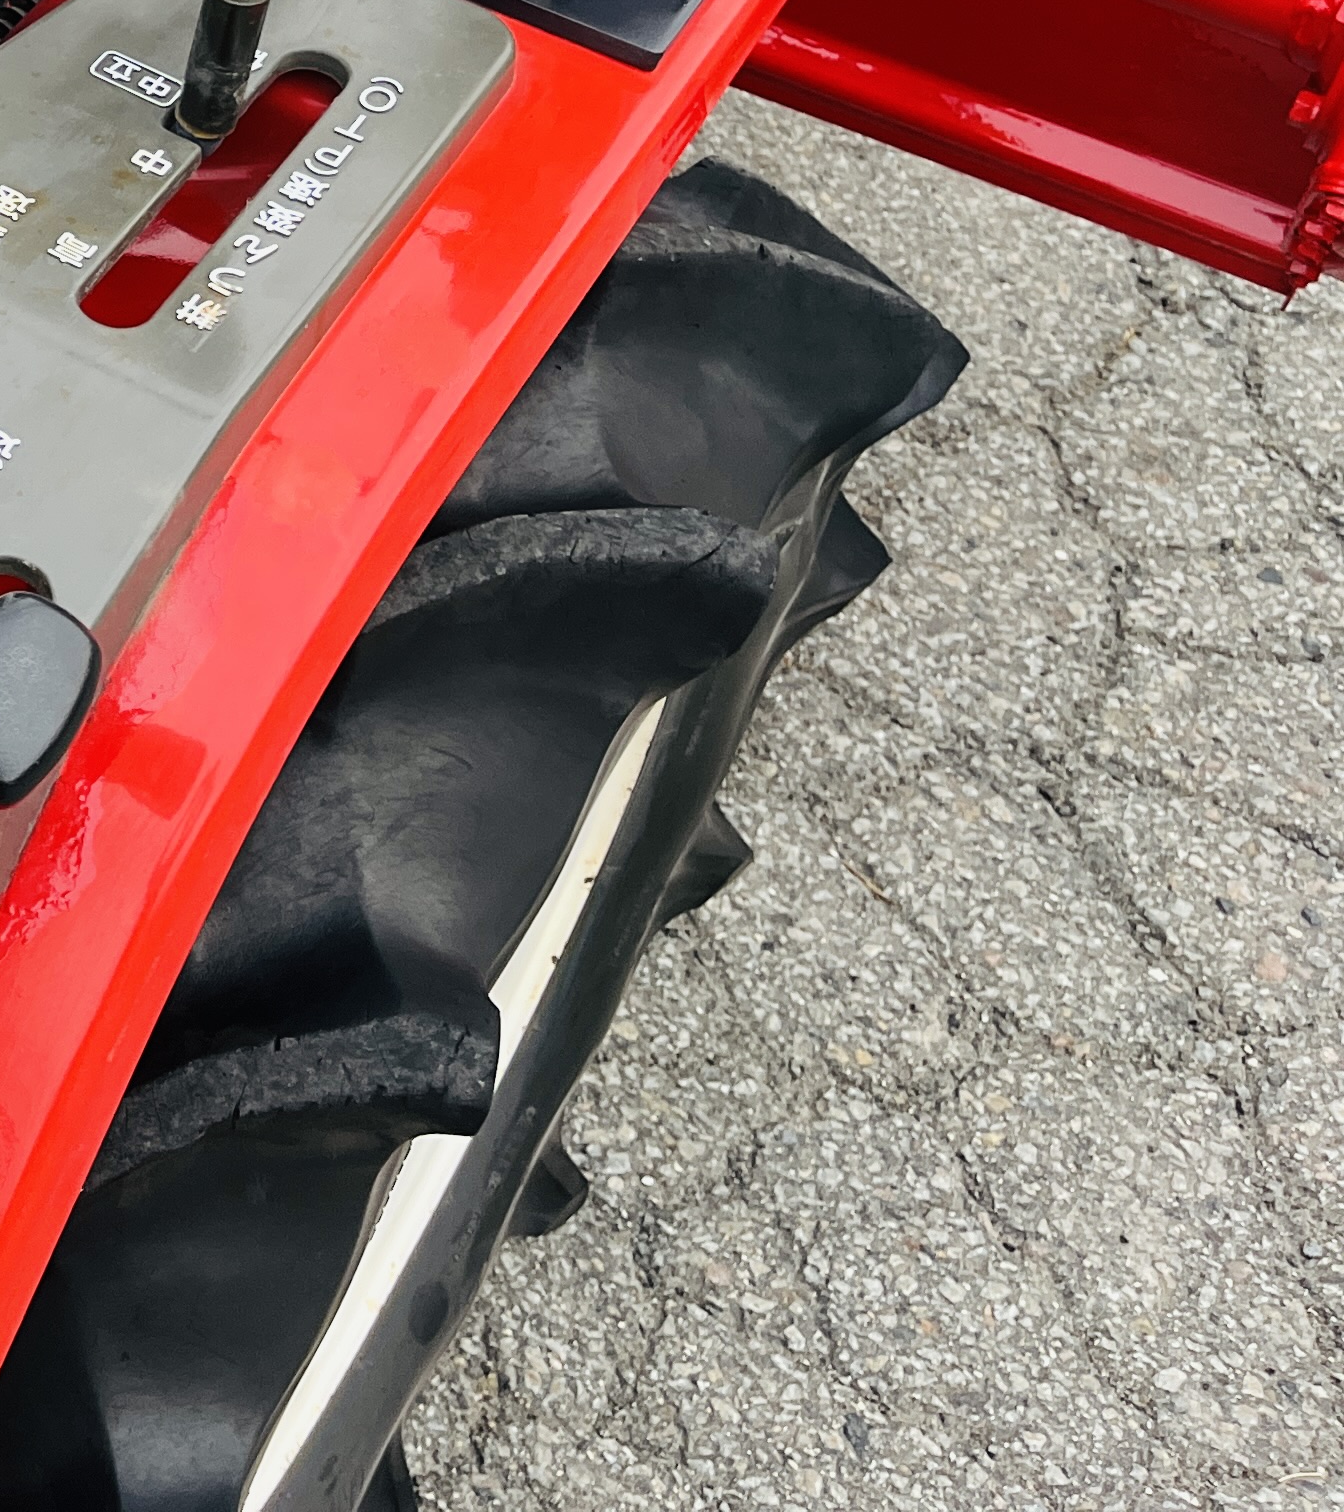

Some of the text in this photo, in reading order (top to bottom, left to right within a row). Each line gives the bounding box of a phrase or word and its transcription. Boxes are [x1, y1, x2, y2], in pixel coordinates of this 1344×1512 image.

[106, 54, 173, 101] 中立
[130, 145, 173, 178] 中
[46, 230, 100, 270] 高
